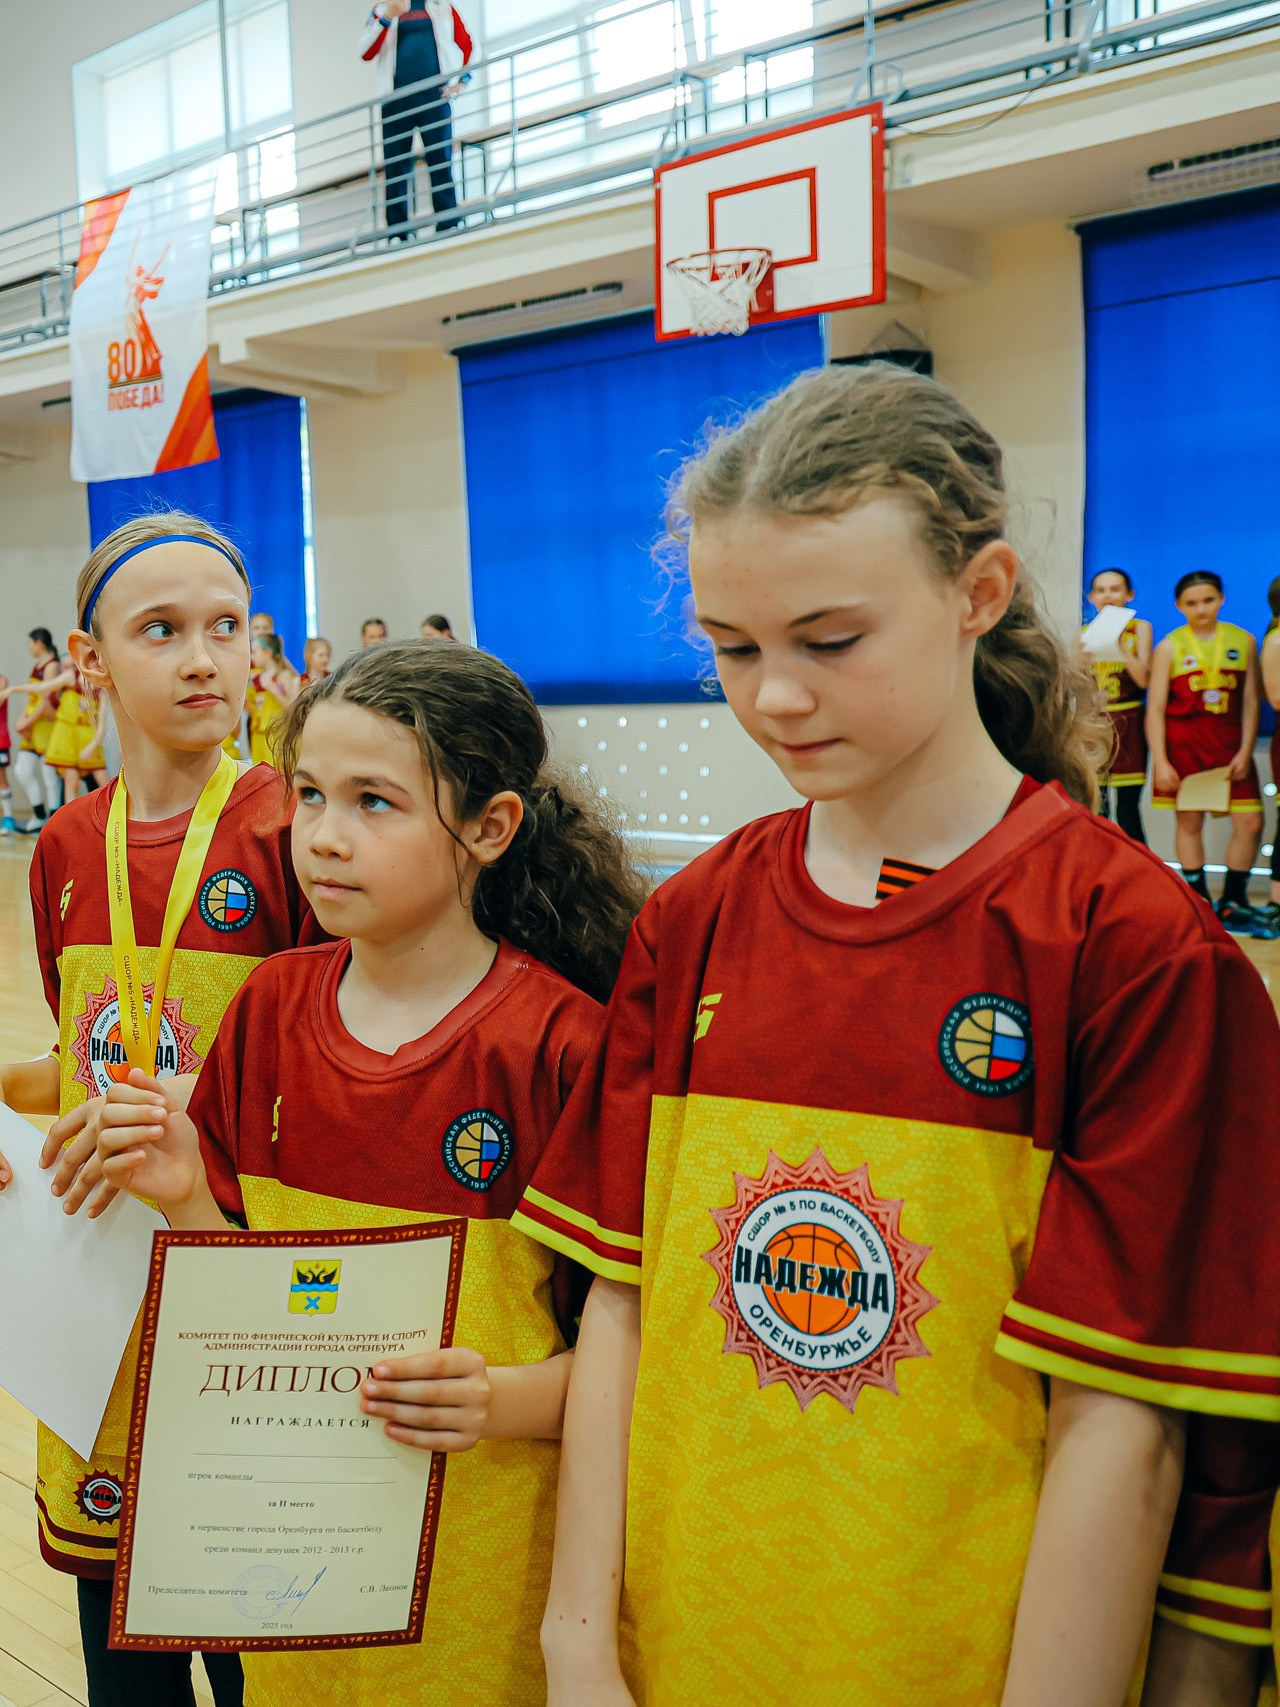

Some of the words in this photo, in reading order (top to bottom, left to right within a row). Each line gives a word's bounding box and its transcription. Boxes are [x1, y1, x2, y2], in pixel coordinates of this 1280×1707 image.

[107, 338, 137, 383] 80
[107, 384, 164, 412] ПОБЕДА!
[200, 882, 216, 926] РОССИЙСКАЯ
[212, 871, 249, 885] ФЕДЕРАЦИЯ
[124, 955, 132, 980] СШОР
[97, 1013, 110, 1034] СШОР
[445, 1124, 468, 1183] РОССИЙСКАЯ
[747, 1211, 772, 1242] СШОР
[775, 1204, 787, 1217] №
[789, 1201, 796, 1211] 5
[799, 1200, 816, 1211] ПО
[820, 1201, 883, 1264] БАСКЕТБОЛУ
[734, 1245, 890, 1314] НАДЕЖДА
[178, 1332, 230, 1340] КОМИТЕТ
[251, 1332, 325, 1341] ФИЗИЧЕСКОЙ
[328, 1334, 379, 1343] КУЛЬТУРЕ
[391, 1329, 428, 1341] СПОРТУ
[749, 1304, 873, 1361] ОРЕНБУРЖЬЕ
[204, 1343, 302, 1351] АДМИНИСТРАЦИИ
[304, 1344, 345, 1352] ГОРОДА
[348, 1344, 405, 1353] ОРЕНБУРГА
[199, 1364, 376, 1397] ДИПЛО
[231, 1416, 370, 1428] НАГРАЖДАЕТСЯ
[188, 1473, 212, 1481] игрок
[197, 1525, 245, 1533] первенстве
[247, 1526, 276, 1534] города
[278, 1526, 323, 1535] Оренбурга
[337, 1525, 383, 1534] баскетболу
[204, 1546, 229, 1554] среди
[265, 1547, 300, 1555] девушек
[302, 1546, 322, 1554] 2012
[330, 1546, 350, 1554] 2013
[148, 1585, 205, 1595] Председатель
[208, 1588, 248, 1596] комитета
[379, 1583, 408, 1592] Леонов
[261, 1622, 279, 1630] 2025
